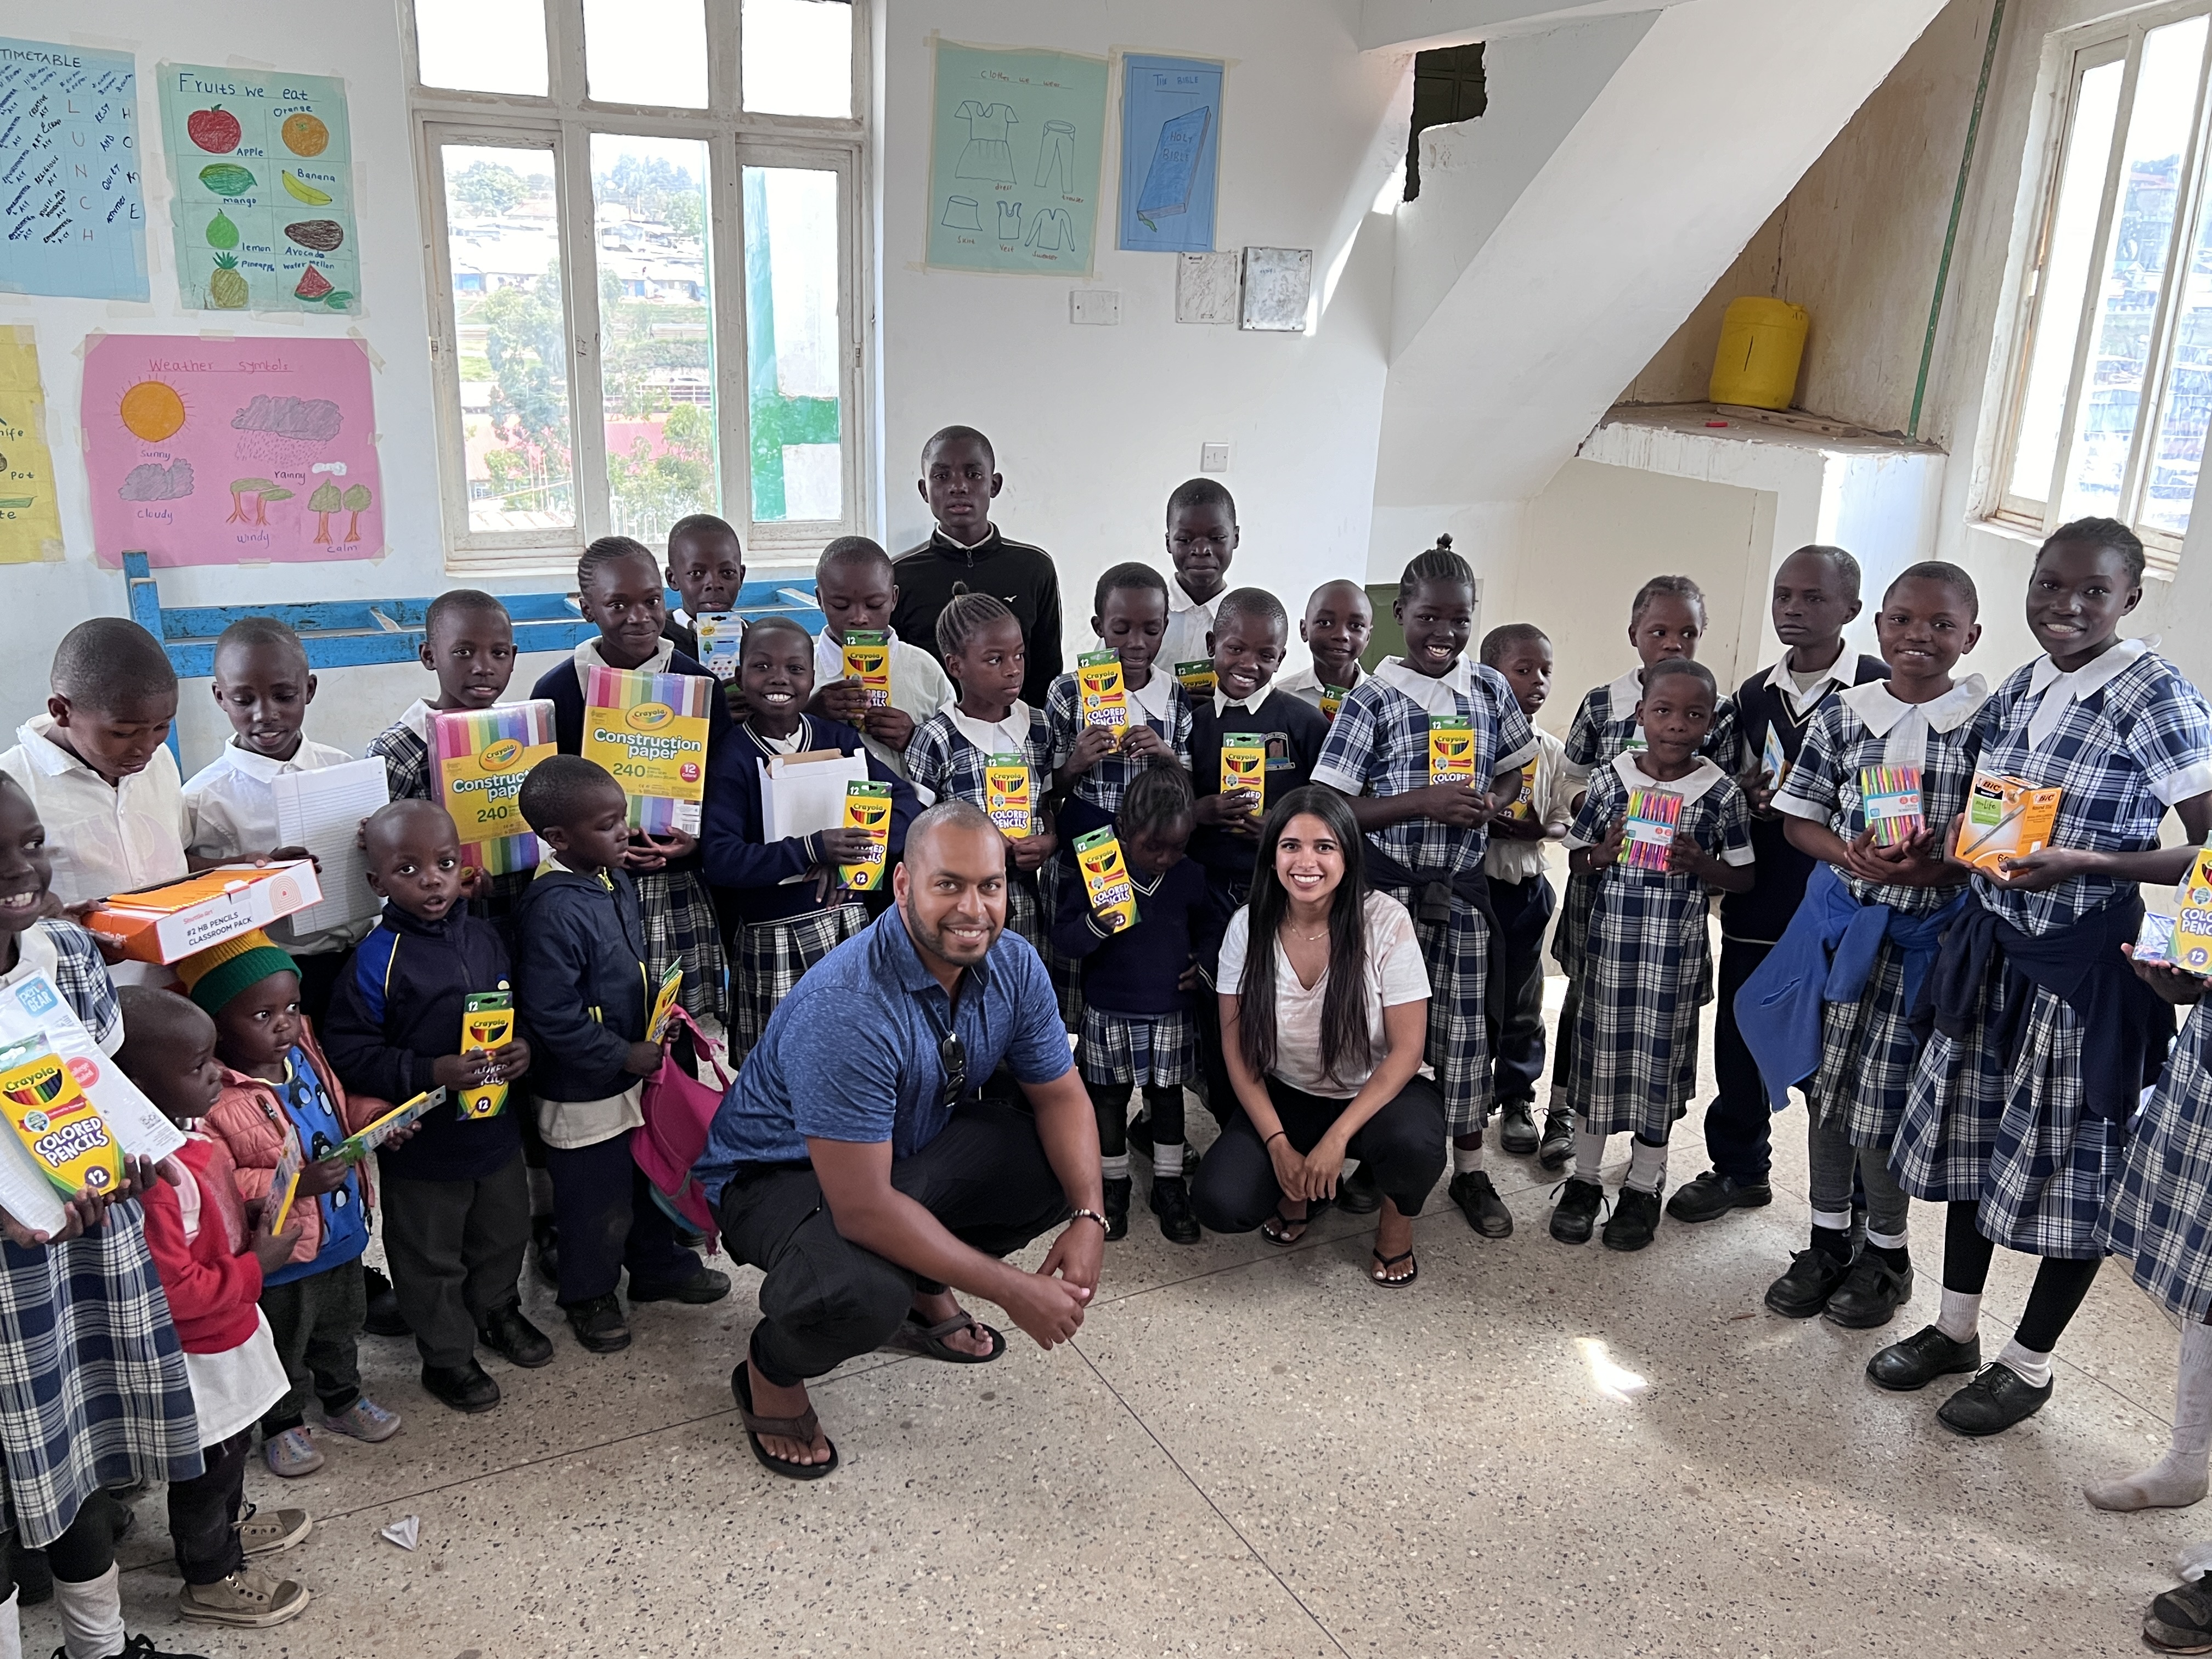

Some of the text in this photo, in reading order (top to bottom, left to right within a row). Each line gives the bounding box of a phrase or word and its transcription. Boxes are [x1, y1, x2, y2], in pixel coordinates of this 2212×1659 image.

[0, 48, 82, 68] TIMETABLE
[245, 86, 265, 98] we
[282, 88, 309, 101] eat
[273, 105, 313, 117] Orange
[1162, 148, 1189, 162] BIBLE
[297, 168, 336, 182] Banana
[223, 196, 257, 208] mango
[242, 242, 271, 252] lemon
[999, 243, 1015, 253] Vest
[149, 358, 289, 373] Weather symbols
[137, 508, 173, 524] cloudy
[236, 530, 270, 548] windy
[327, 544, 358, 554] calm
[847, 636, 856, 645] 12
[1081, 658, 1090, 668] 12
[1086, 670, 1115, 680] Crayola
[1325, 690, 1335, 698] 12
[634, 708, 665, 718] Crayola
[1087, 707, 1126, 721] COLORED
[1432, 721, 1442, 730] 12
[593, 728, 702, 752] Construction
[1226, 738, 1235, 747] 12
[487, 744, 516, 759] Crayola
[627, 743, 679, 761] paper
[988, 758, 998, 767] 12
[612, 762, 646, 777] 240
[684, 764, 697, 774] 12
[1432, 773, 1471, 783] COLORE
[850, 786, 860, 795] 12
[1982, 781, 2001, 791] BIC
[853, 803, 883, 811] Crayola
[477, 805, 508, 823] 240
[990, 810, 1029, 820] COLORED
[1077, 842, 1087, 852] 12
[1087, 850, 1114, 863] Crayola
[856, 873, 866, 883] 12
[1093, 883, 1130, 904] COLORED
[198, 922, 208, 932] HB
[210, 911, 239, 929] PENCILS
[188, 916, 253, 946] CLASSROOM PACK
[2191, 950, 2204, 962] 12
[19, 985, 40, 1006] pen
[27, 990, 53, 1012] GEAR
[468, 1001, 479, 1012] 12
[473, 1018, 506, 1028] Crayola
[4, 1066, 55, 1092] Crayola
[478, 1099, 489, 1110] 12
[34, 1116, 103, 1156] COLORED
[44, 1131, 110, 1167] PENCILS
[87, 1170, 108, 1186] 12
